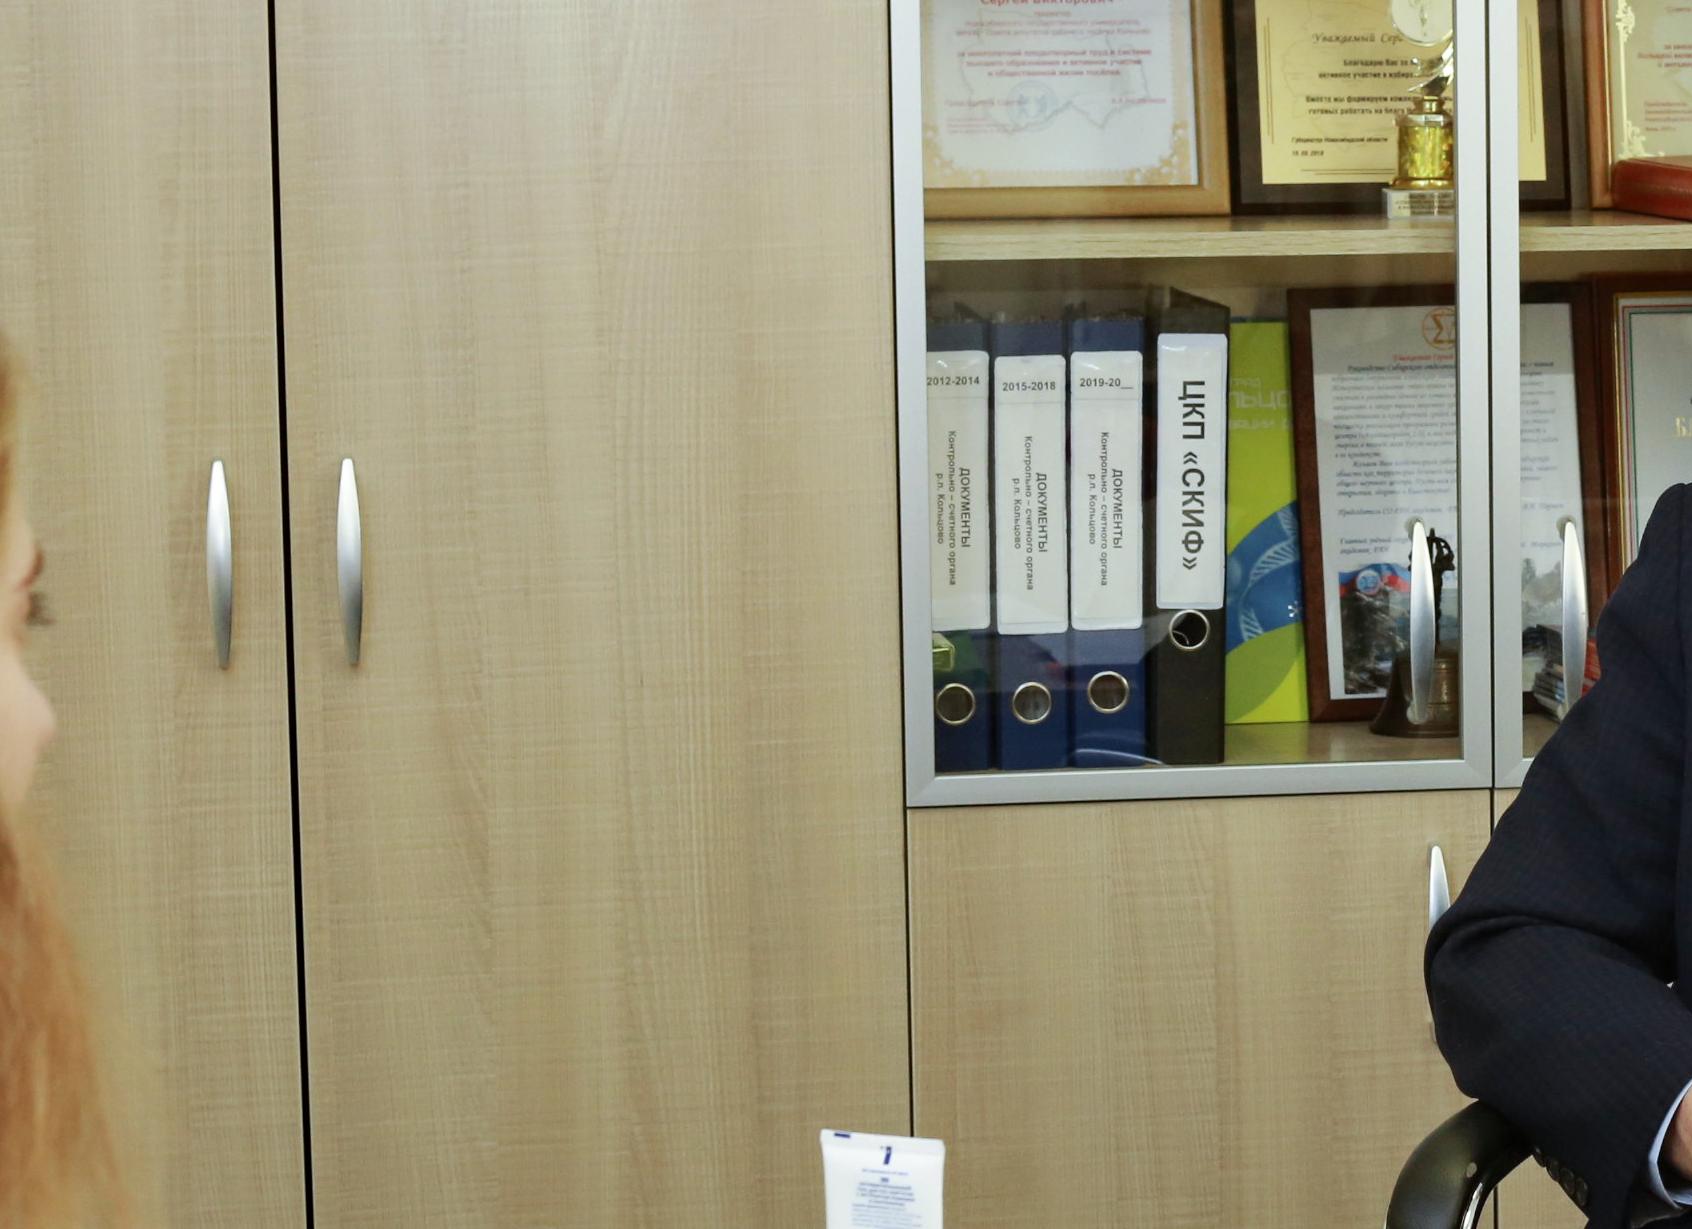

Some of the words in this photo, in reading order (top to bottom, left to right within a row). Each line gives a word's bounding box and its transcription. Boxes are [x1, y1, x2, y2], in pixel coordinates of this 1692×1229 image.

[927, 377, 980, 386] 2012-2014
[1003, 382, 1056, 391] 2015-2018
[1178, 380, 1206, 440] ЦКП
[947, 431, 956, 493] Контрольно
[1024, 436, 1033, 497] Контрольно
[1100, 432, 1109, 493] Контрольно
[937, 494, 945, 544] Кольцово
[959, 468, 971, 548] ДОКУМЕНТЫ
[1014, 499, 1022, 549] Кольцово
[1036, 472, 1048, 552] ДОКУМЕНТЫ
[1089, 495, 1097, 545] Кольцово
[1112, 469, 1123, 549] ДОКУМЕНТЫ
[1180, 451, 1206, 571] «СКИФ»
[948, 551, 956, 585] органа
[1025, 556, 1033, 590] органа
[1100, 552, 1108, 586] органа
